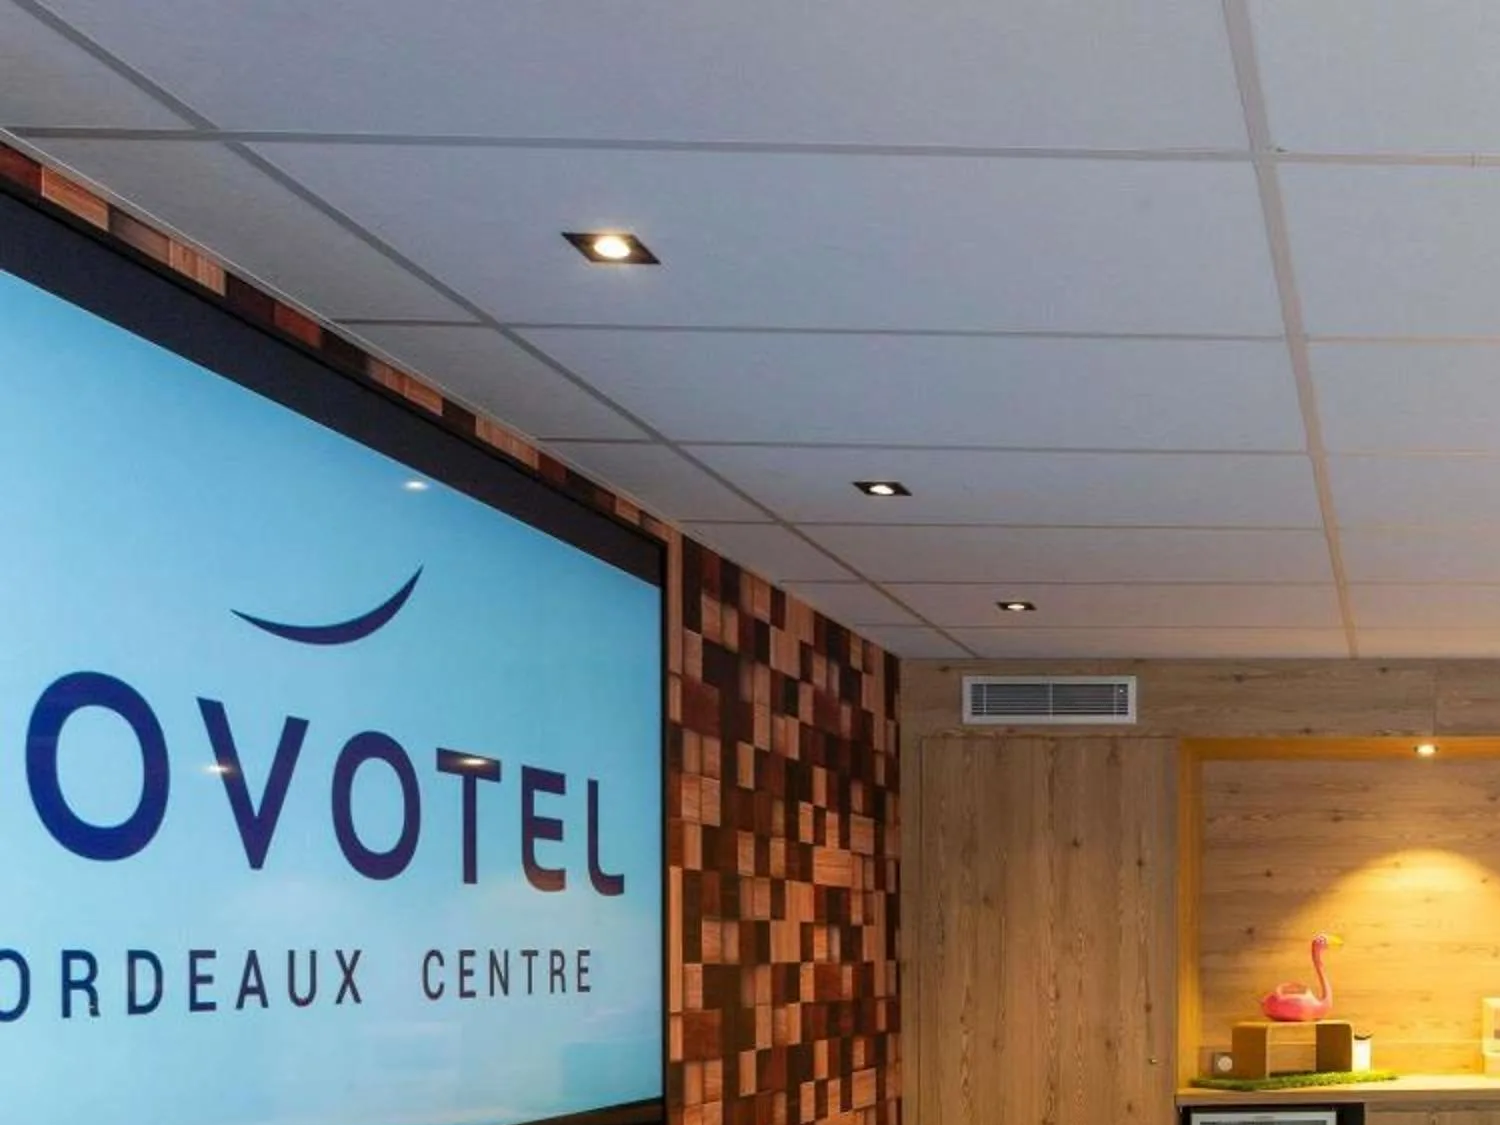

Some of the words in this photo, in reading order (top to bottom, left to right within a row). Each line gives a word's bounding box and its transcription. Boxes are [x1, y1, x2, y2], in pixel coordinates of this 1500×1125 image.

[25, 670, 626, 897] OVOTEL
[0, 948, 363, 1023] ORDEAUX
[422, 948, 592, 1001] CENTRE
